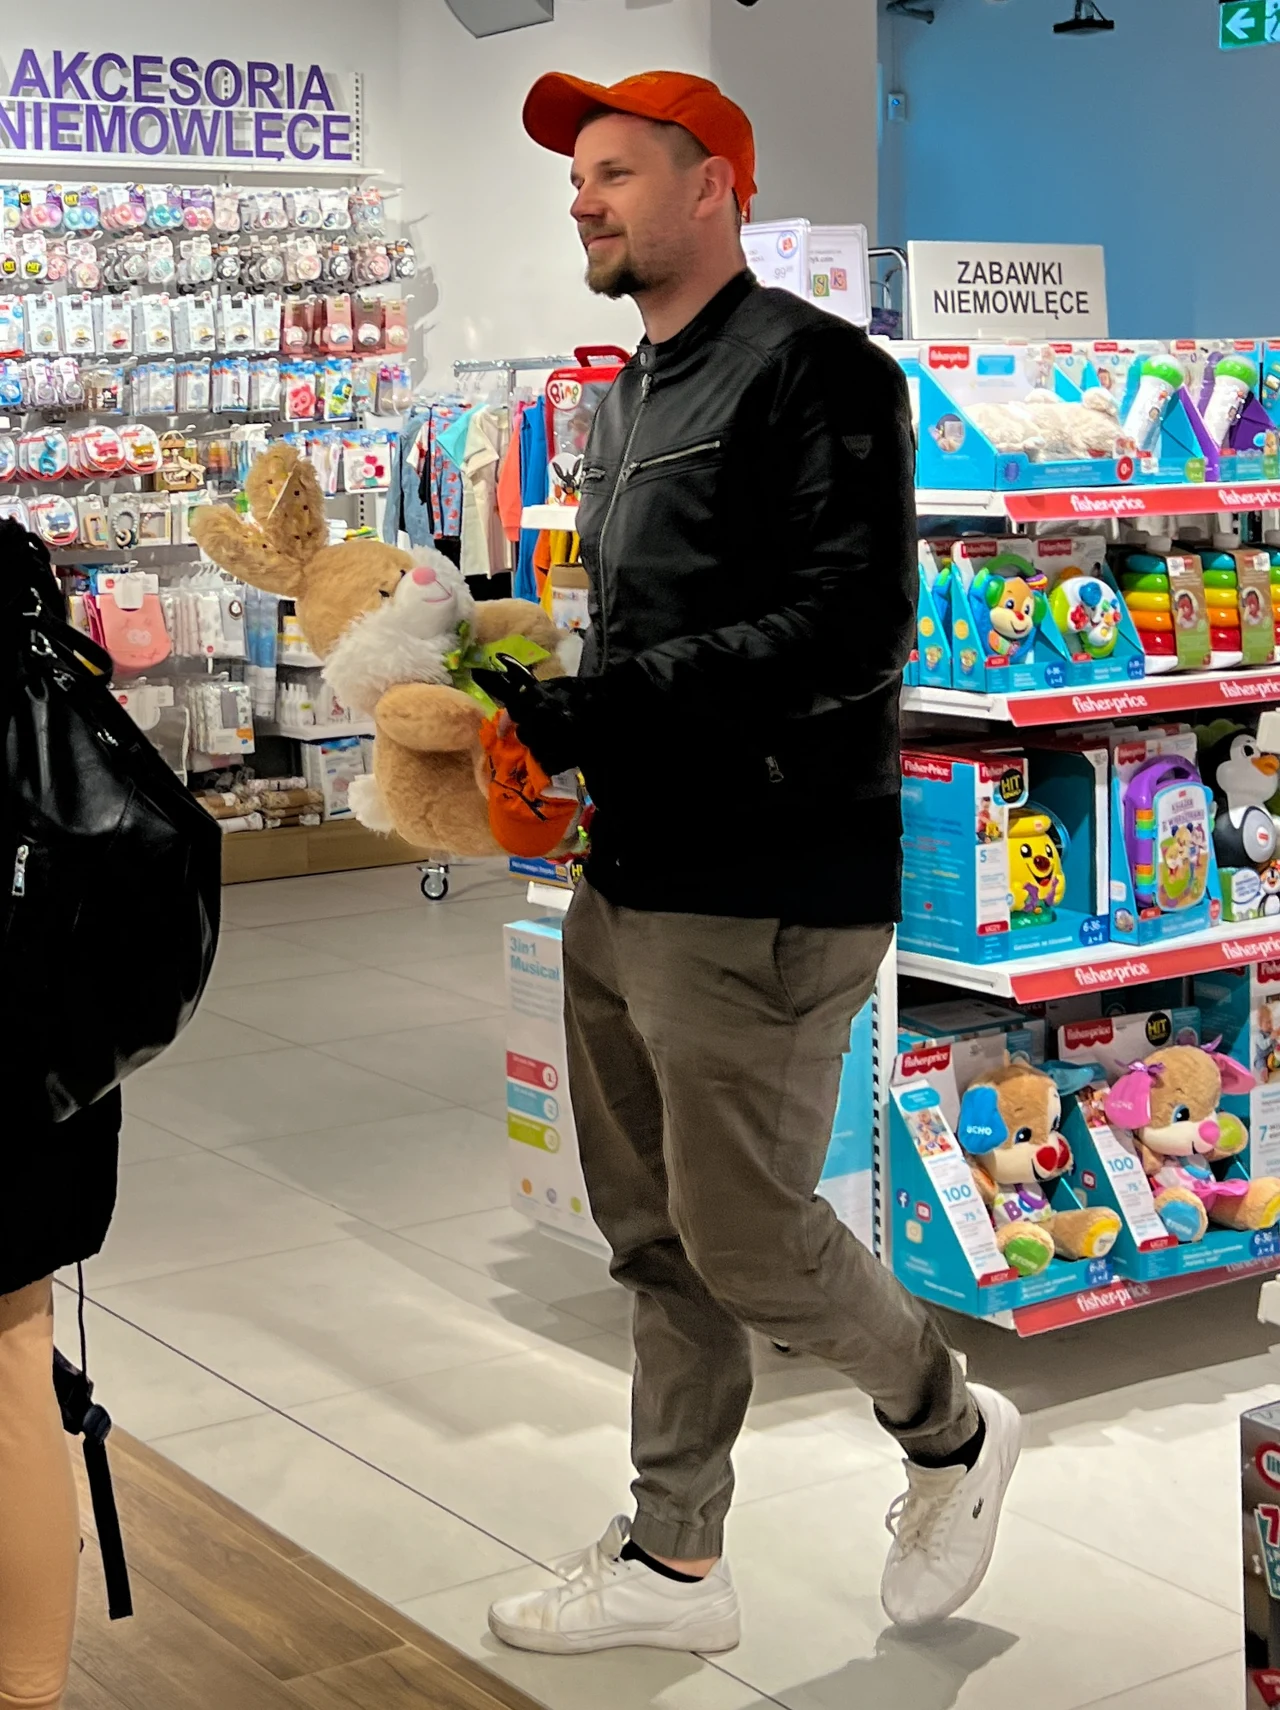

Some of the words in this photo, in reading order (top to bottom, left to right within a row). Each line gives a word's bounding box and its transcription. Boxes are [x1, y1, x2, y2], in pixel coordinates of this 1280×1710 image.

[9, 48, 335, 111] AKCESORIA
[0, 99, 353, 162] NIEMOWLĘCE
[957, 260, 1064, 286] ZABAWKI
[933, 289, 1091, 320] NIEMOWLĘCE
[1070, 494, 1146, 514] fisher-price
[1218, 489, 1280, 507] fisher-pric
[1220, 679, 1280, 698] fisher-pric
[1072, 693, 1148, 714] fisher-price
[1002, 774, 1021, 793] HIT
[510, 936, 537, 957] 3in1
[1221, 936, 1280, 960] fisher-pric
[510, 954, 560, 981] Musical
[1074, 961, 1150, 986] fisher-price
[1148, 1018, 1167, 1036] HIT
[1107, 1156, 1134, 1173] 100
[943, 1184, 972, 1202] 100
[1077, 1283, 1151, 1312] fisher-price
